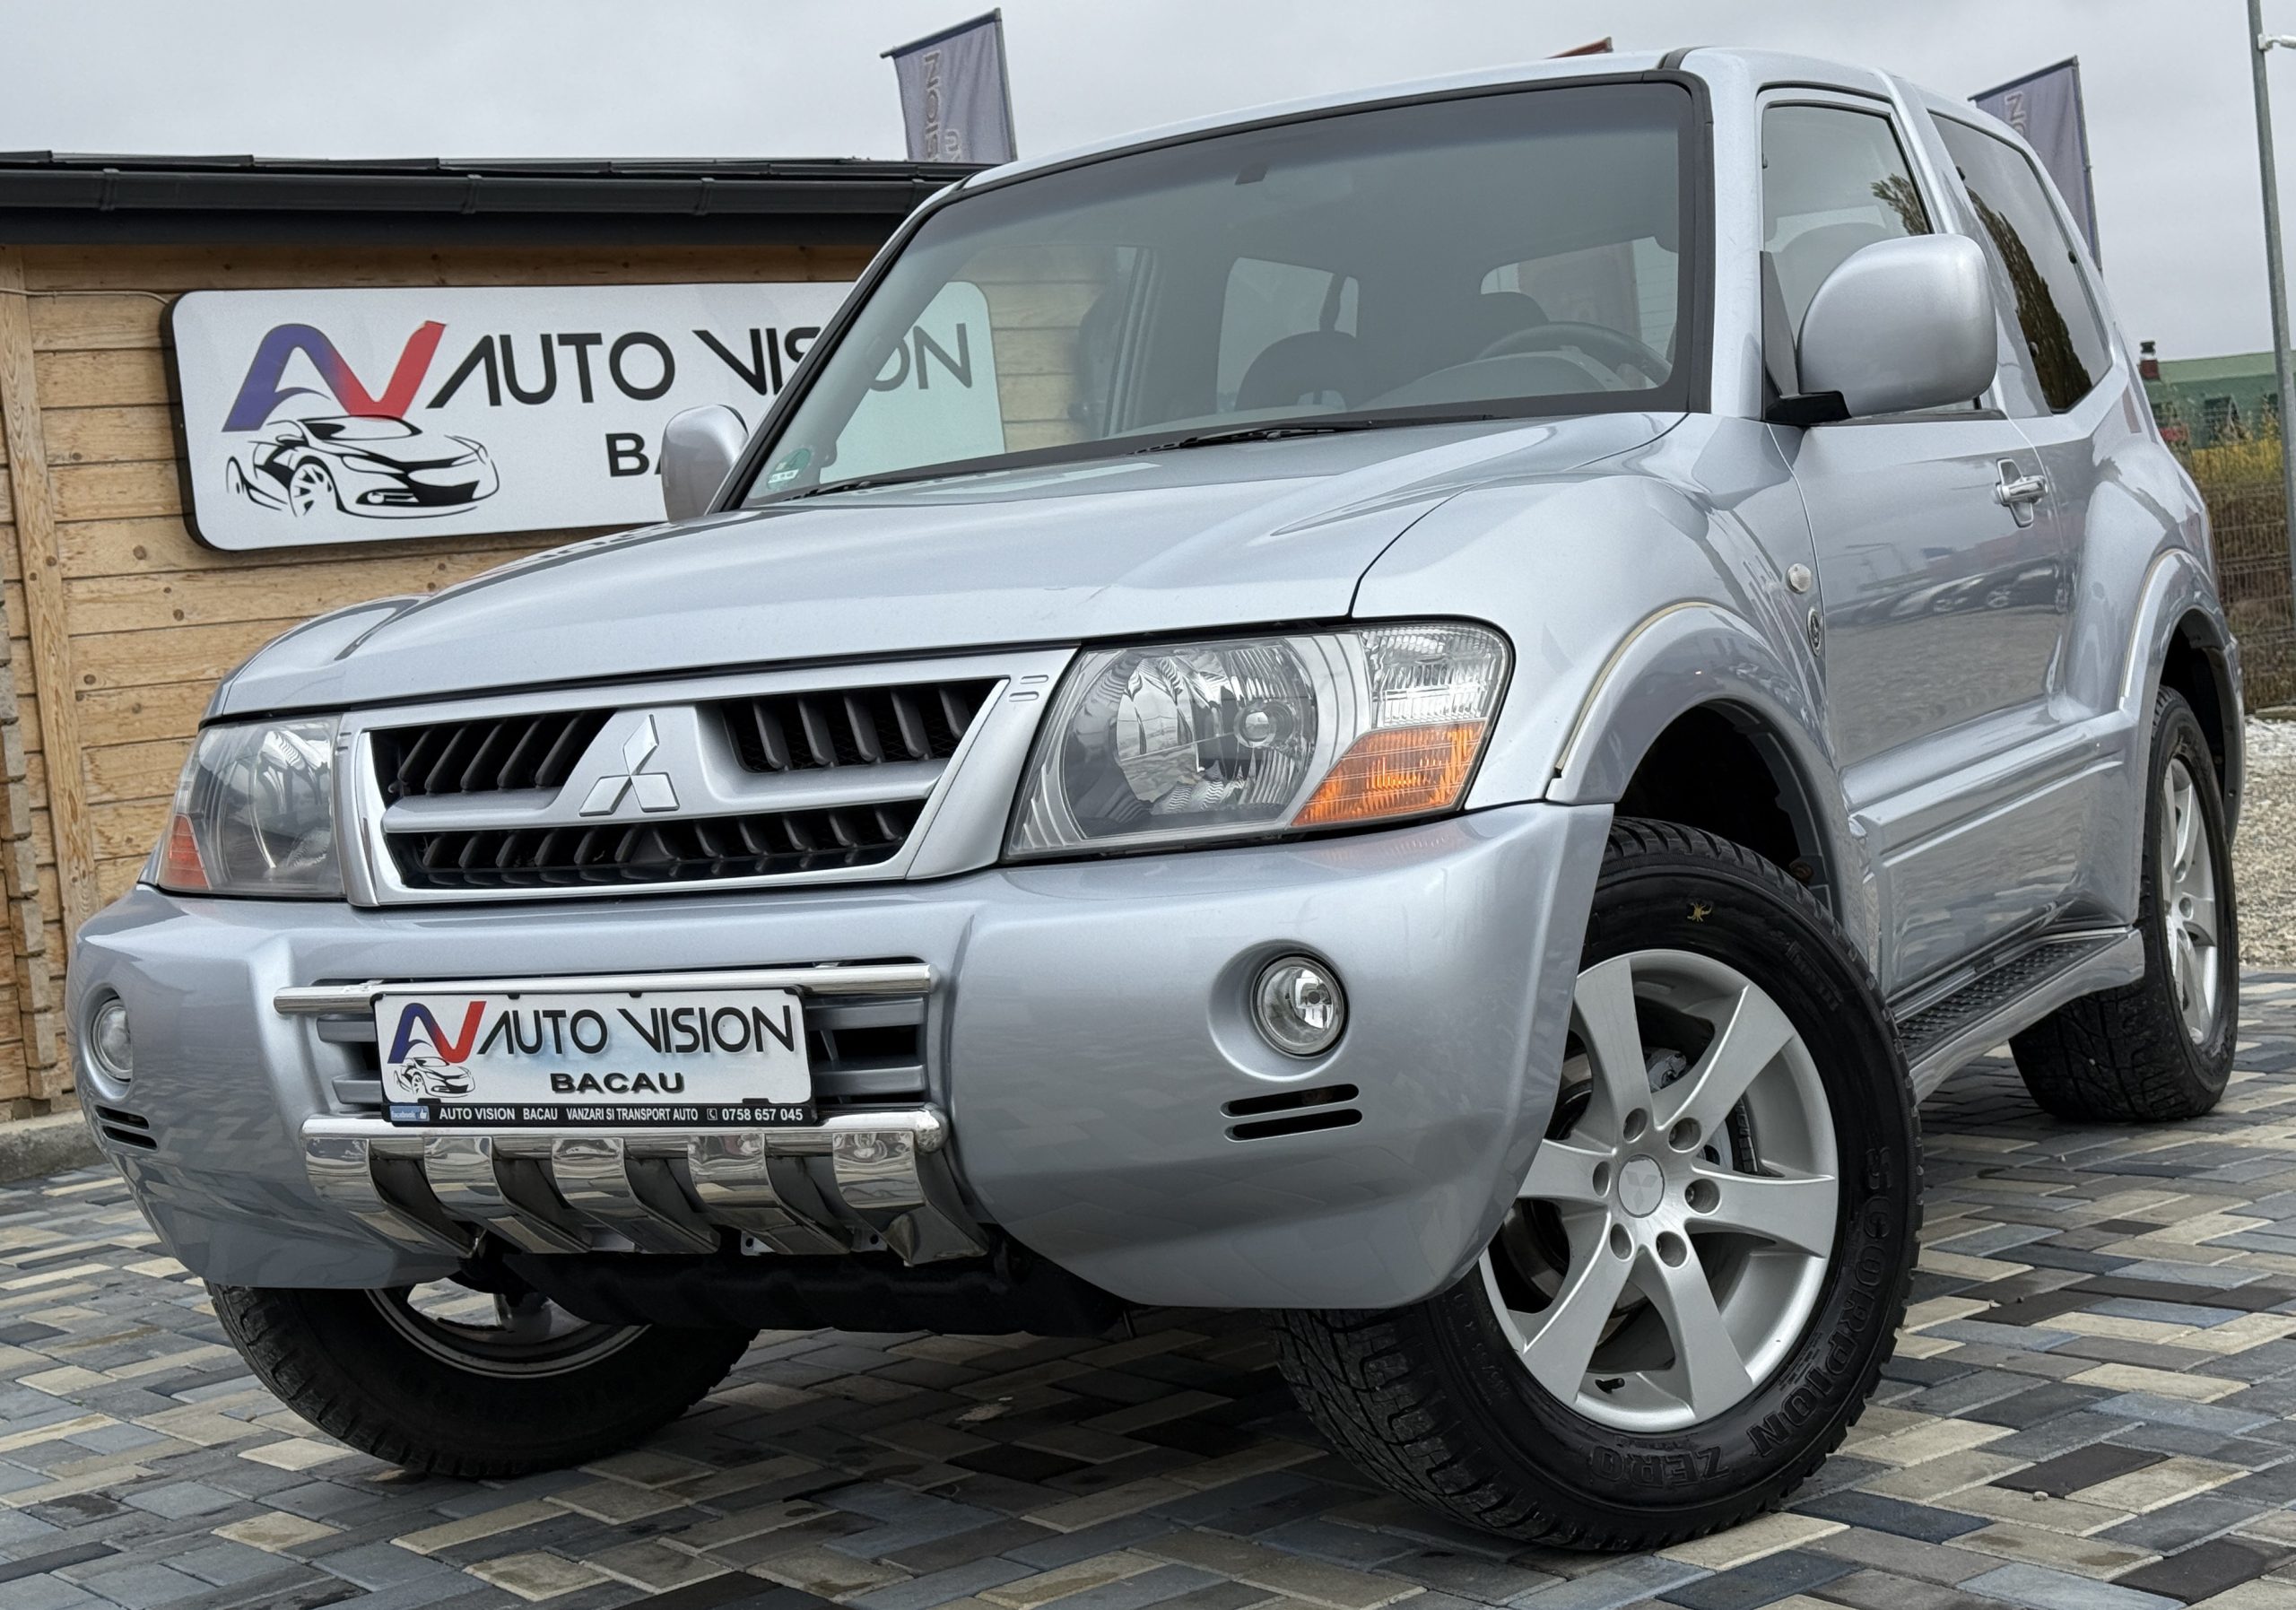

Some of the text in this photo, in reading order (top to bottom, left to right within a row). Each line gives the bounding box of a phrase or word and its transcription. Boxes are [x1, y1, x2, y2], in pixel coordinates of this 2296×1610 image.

[426, 322, 972, 409] AUTO VISON
[477, 1004, 796, 1055] AUTO VISION
[550, 1072, 685, 1094] BACAU
[439, 1108, 473, 1121] AUTO
[474, 1108, 516, 1121] VISION
[523, 1108, 559, 1121] BACAU
[566, 1108, 604, 1121] VANZARI
[605, 1108, 615, 1121] SI
[616, 1108, 671, 1121] TRANSPORT
[673, 1108, 699, 1121] AUTO
[721, 1108, 752, 1121] 0758
[754, 1108, 777, 1121] 657
[780, 1108, 804, 1121] 045
[1587, 1443, 1732, 1489] ZERO
